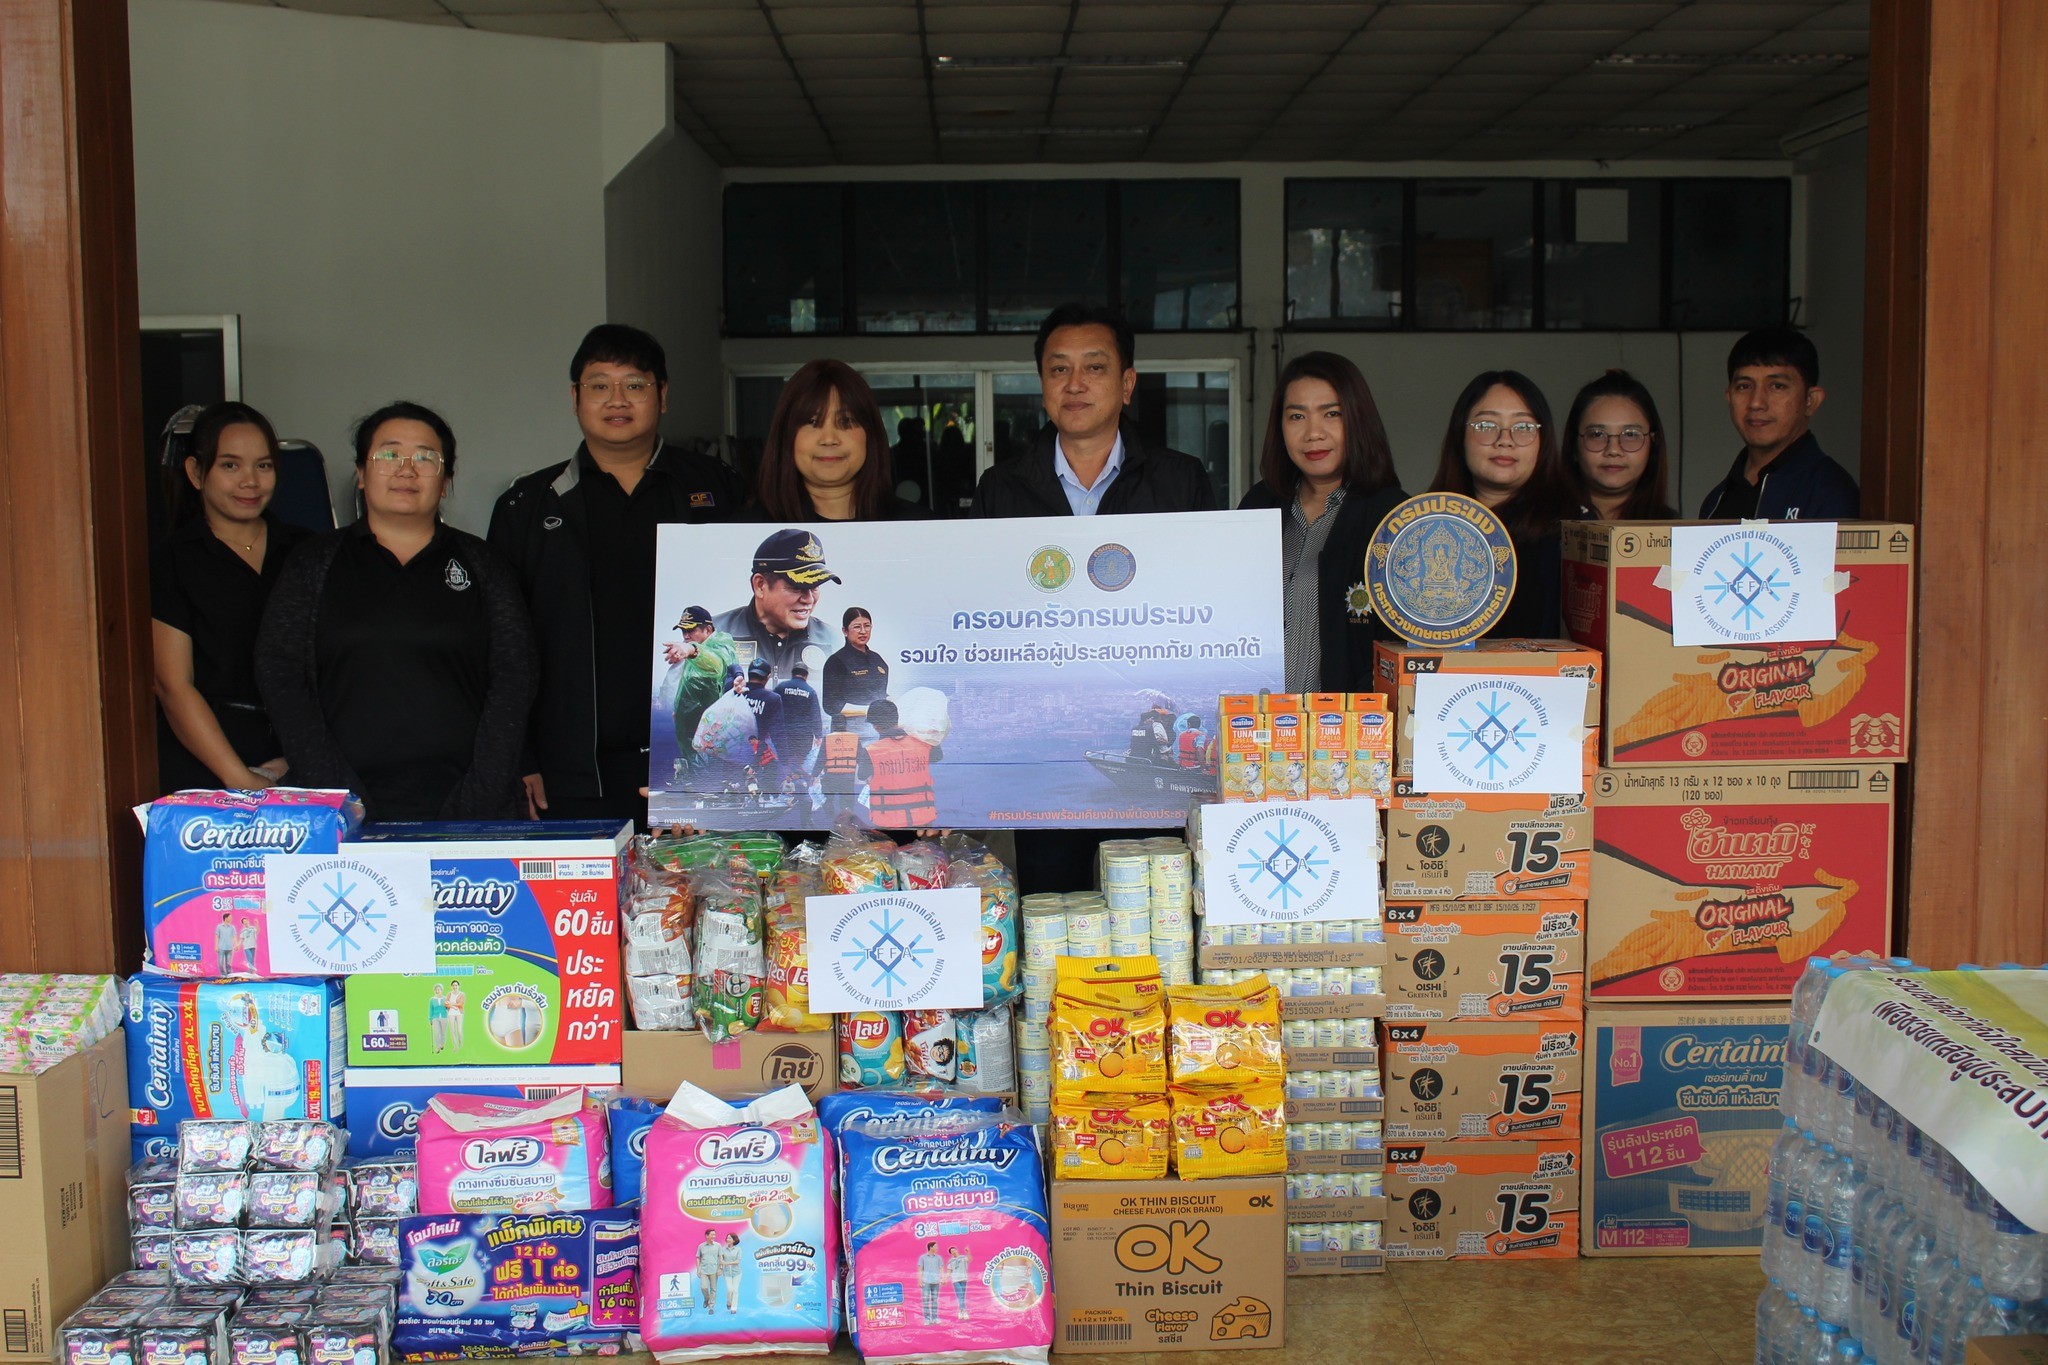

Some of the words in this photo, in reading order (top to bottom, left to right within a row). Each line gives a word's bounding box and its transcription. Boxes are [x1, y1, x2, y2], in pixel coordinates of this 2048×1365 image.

[1387, 495, 1497, 536] กรมประมง
[1623, 536, 1636, 553] 5
[952, 602, 1214, 630] ครอบครัวกรมประมง
[1372, 582, 1508, 641] กระทรวงเกษตรและสหกรณ์
[1694, 595, 1708, 615] THAI
[1704, 614, 1732, 638] FROZEN
[1733, 632, 1761, 641] FOODS
[1764, 591, 1800, 638] ASSOCIATION
[900, 643, 958, 664] รวมใจ
[964, 641, 1193, 668] ช่วยเหลือผู้ประสบอุทกภัย
[1200, 636, 1262, 661] ภาคใต้
[1407, 660, 1436, 671] 6x4
[1720, 660, 1813, 689] ORIGINAL
[1754, 683, 1812, 710] FLAVOUR
[1232, 730, 1254, 738] TUNA
[1276, 729, 1297, 737] TUNA
[1320, 727, 1341, 736] TUNA
[1362, 727, 1383, 736] TUNA
[878, 748, 928, 777] กรมประมง
[1437, 741, 1450, 762] THAI
[1446, 761, 1474, 787] FROZEN
[1476, 781, 1505, 791] FOODS
[1508, 742, 1547, 788] ASSOCIATION
[1600, 776, 1613, 793] 5
[1624, 773, 1666, 788] น้ำหนักสุทธิ
[1669, 776, 1680, 787] 13
[1683, 774, 1700, 788] กรัม
[1712, 776, 1723, 787] 12
[1726, 776, 1743, 788] ซอง
[1756, 775, 1767, 786] 10
[1769, 776, 1782, 790] ถุง
[1682, 790, 1701, 802] (120
[1704, 790, 1724, 802] ซอง)
[1722, 812, 1779, 827] ข้าวเกรียบกุ้ง
[184, 820, 307, 852] Certainty
[1692, 823, 1800, 858] ฮานามิ
[1507, 831, 1561, 874] 15
[1559, 861, 1575, 869] บาท
[1706, 862, 1784, 880] HANAMI
[568, 889, 599, 908] รุ่นลัง
[1227, 873, 1243, 894] THAI
[1238, 893, 1267, 918] FROZEN
[1269, 909, 1300, 920] FOODS
[1302, 869, 1341, 917] ASSOCIATION
[1388, 909, 1416, 920] 6x4
[1699, 899, 1790, 926] ORIGINAL
[469, 922, 489, 933] 900
[553, 907, 590, 937] 60
[589, 910, 614, 937] ชิ้น
[1732, 922, 1790, 947] FLAVOUR
[288, 923, 303, 945] THAI
[300, 943, 329, 968] FROZEN
[330, 961, 359, 972] FOODS
[361, 923, 399, 968] ASSOCIATION
[1502, 944, 1555, 952] ขายปลีกขวดละ
[565, 949, 606, 976] ประ
[832, 961, 844, 982] THAI
[841, 981, 872, 1006] FROZEN
[873, 998, 904, 1009] FOODS
[906, 957, 945, 1005] ASSOCIATION
[1499, 954, 1554, 996] 15
[565, 980, 615, 1010] หยัด
[1415, 982, 1442, 991] OISHI
[1552, 983, 1568, 991] บาท
[482, 984, 513, 1011] สวมง่าย
[513, 982, 548, 1010] กันรั่วซึม
[184, 998, 195, 1040] XL-XXL
[1090, 1017, 1131, 1039] OK
[1205, 1009, 1247, 1029] OK
[854, 1018, 887, 1040] เลย์
[1391, 1029, 1419, 1040] 6x4
[371, 1037, 386, 1049] 60
[146, 999, 175, 1109] Certainty
[1613, 1052, 1639, 1069] No.1
[771, 1056, 816, 1083] เลย์
[1502, 1063, 1554, 1072] ขายปลีกขวดละ
[1704, 1068, 1749, 1084] เซอร์เทนตี้
[1749, 1071, 1768, 1083] เทป
[1208, 1093, 1251, 1113] OK
[1499, 1073, 1553, 1115] 15
[1681, 1090, 1729, 1106] ซึมซับดี
[1551, 1102, 1567, 1110] บาท
[1091, 1109, 1135, 1126] OK
[709, 1135, 768, 1161] ไลฟ์รี่
[1607, 1123, 1694, 1157] รุ่นลังประหยัด
[473, 1141, 530, 1164] ไลฟ์รี่
[1390, 1149, 1418, 1160] 6x4
[1622, 1146, 1664, 1170] 112
[1666, 1144, 1686, 1162] ชิ้น
[457, 1174, 553, 1190] กางเกงซึมซับสบาย
[689, 1172, 789, 1188] กางเกงซึมซับสบาย
[914, 1173, 986, 1191] กางเกงซึมซับ
[1500, 1183, 1552, 1191] ขายปลีกขวดละ
[686, 1195, 746, 1208] สวมใส่เองได้ง่าย
[907, 1189, 995, 1210] กระชับสบาย
[1120, 1198, 1138, 1206] OK
[1139, 1197, 1167, 1206] THIN
[1170, 1195, 1216, 1205] BISCUIT
[1248, 1195, 1274, 1208] OK
[1113, 1208, 1145, 1216] CHEESE
[1145, 1207, 1176, 1215] FLAVOR
[1177, 1206, 1193, 1215] (OK
[1193, 1206, 1224, 1215] BRAND)
[1496, 1193, 1550, 1234] 15
[407, 1219, 460, 1246] โฉมใหม่!
[486, 1216, 582, 1249] แพ็กพิเศษ
[915, 1223, 926, 1238] 3
[1549, 1221, 1564, 1229] บาท
[1601, 1230, 1618, 1246] M
[1622, 1228, 1646, 1246] 112
[515, 1245, 532, 1256] 12
[537, 1244, 557, 1257] ห่อ
[1114, 1219, 1223, 1275] OK
[426, 1256, 464, 1268] ลอรีเอะ
[494, 1261, 522, 1282] ฟรี
[533, 1259, 543, 1278] 1
[552, 1261, 578, 1279] ห่อ
[757, 1258, 786, 1269] ลดกลิ่น
[983, 1255, 1001, 1285] สวมง่าย
[449, 1276, 475, 1288] Safe
[492, 1281, 581, 1300] ได้กำไรเพิ่มเน้นๆ
[1114, 1281, 1155, 1297] Thin
[1161, 1279, 1224, 1296] Biscuit
[600, 1298, 616, 1309] 16
[619, 1296, 636, 1308] บาท
[1144, 1309, 1199, 1323] Cheese
[428, 1327, 446, 1335] ขนาด
[1155, 1322, 1189, 1333] Flavor
[1158, 1332, 1184, 1344] รสชีส
